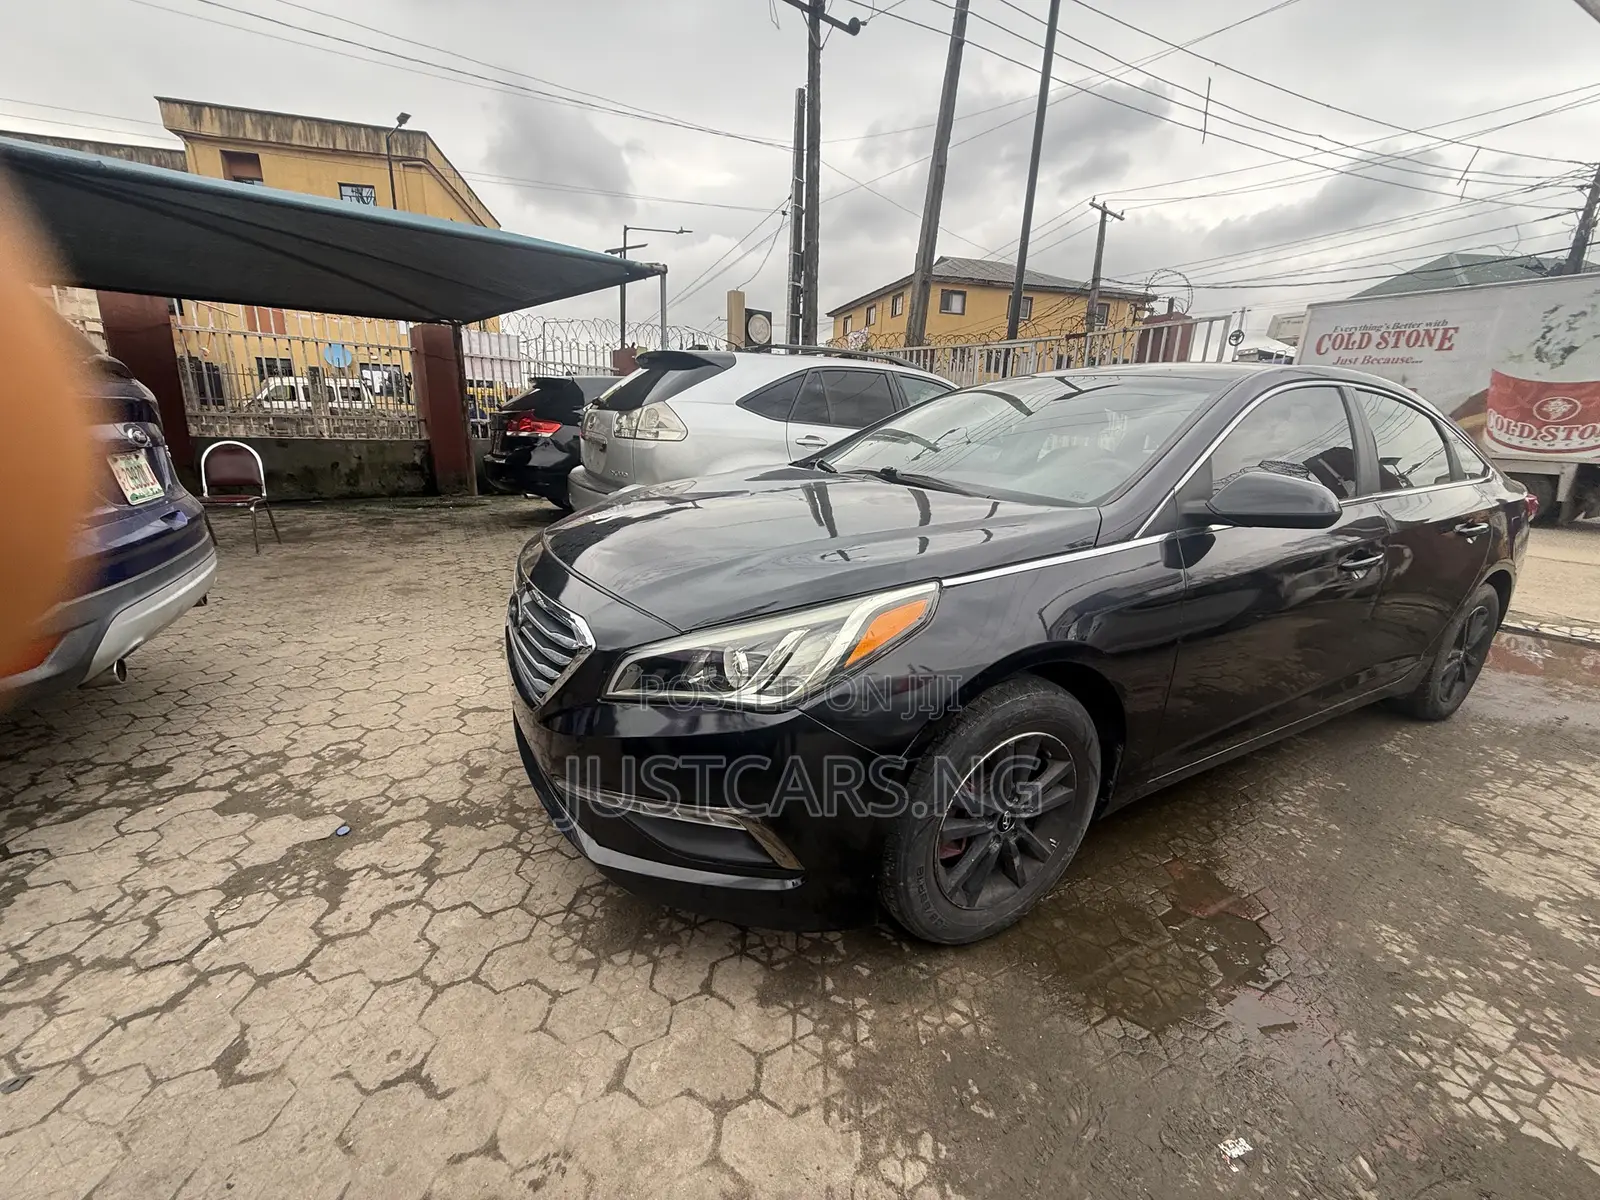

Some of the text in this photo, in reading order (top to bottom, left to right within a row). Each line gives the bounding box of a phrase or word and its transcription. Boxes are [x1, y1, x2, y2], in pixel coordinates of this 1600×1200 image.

[1391, 321, 1425, 331] Better
[1425, 319, 1448, 328] with
[1315, 327, 1459, 355] COLD STONE
[1332, 355, 1423, 366] Just Because...
[1537, 423, 1600, 442] STO
